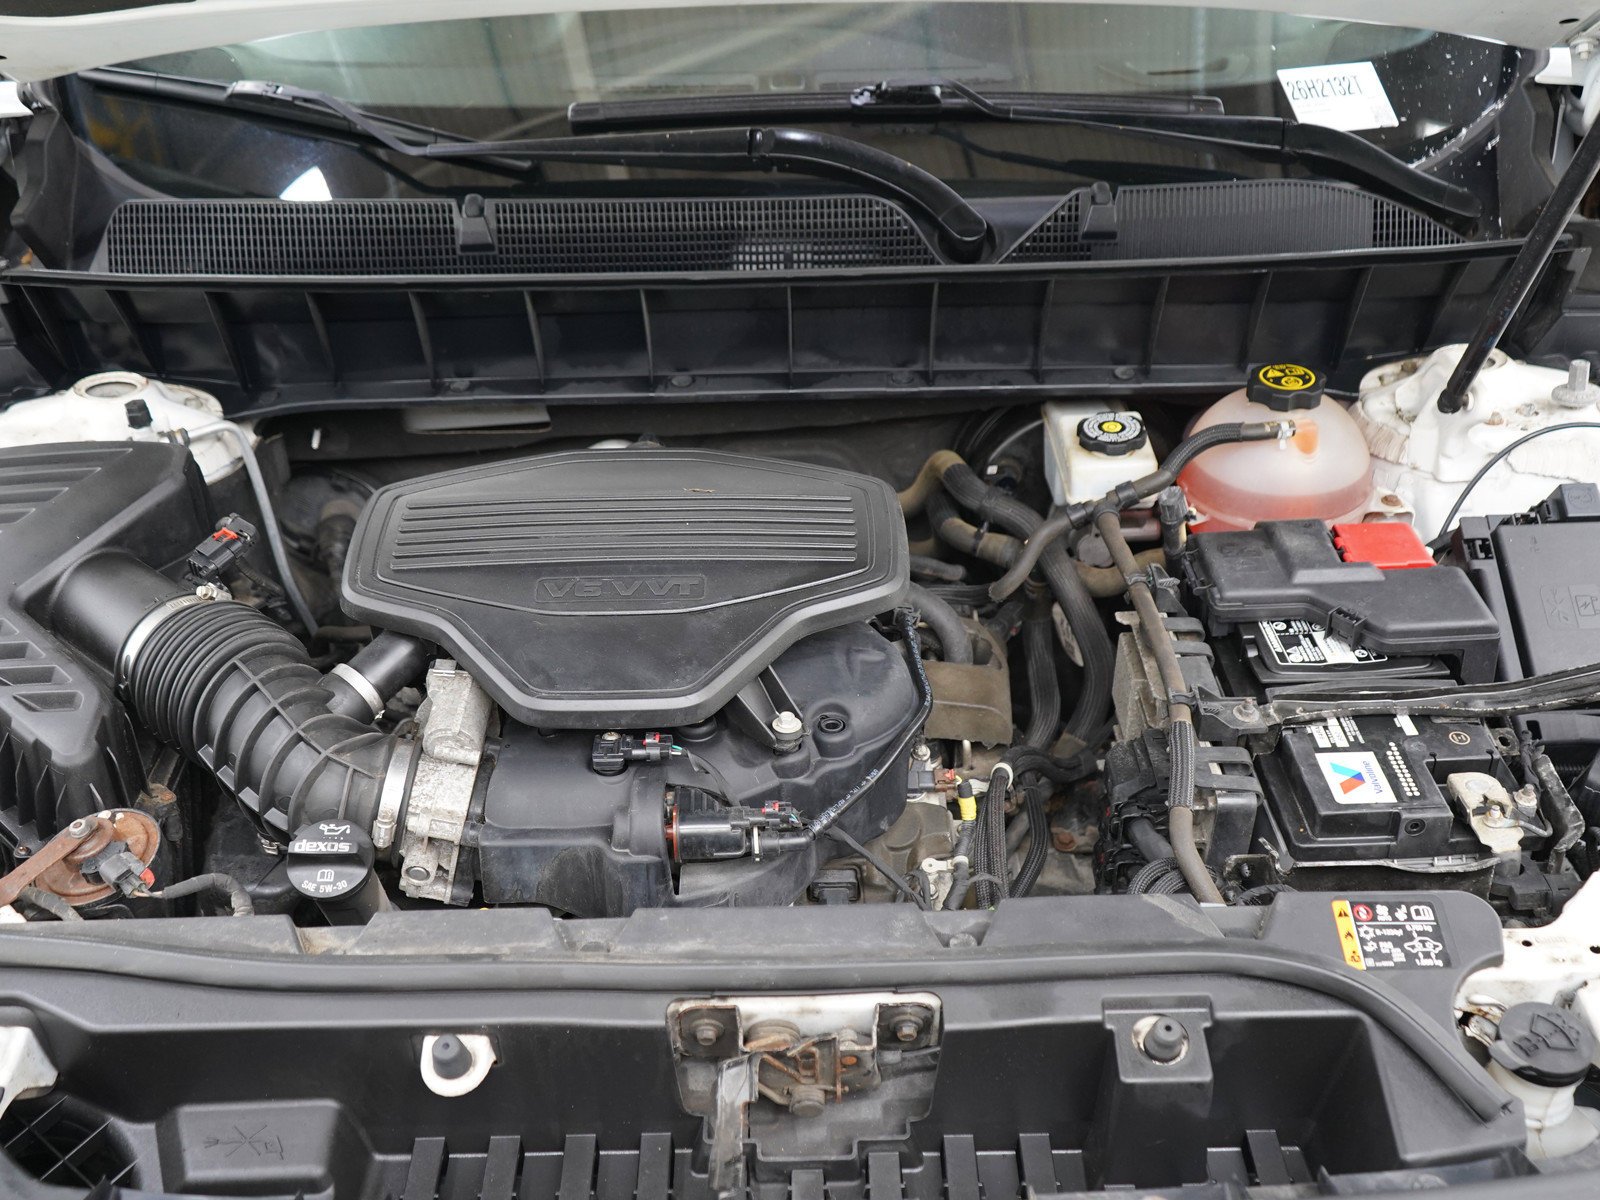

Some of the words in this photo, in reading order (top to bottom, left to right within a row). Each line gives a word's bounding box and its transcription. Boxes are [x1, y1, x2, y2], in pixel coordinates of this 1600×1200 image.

[1286, 74, 1363, 101] 26H2132T
[543, 577, 602, 598] V6
[611, 576, 699, 596] VVT
[1363, 760, 1383, 794] Valvoline
[294, 839, 352, 852] dexos
[302, 880, 317, 892] SAE
[319, 880, 348, 893] 5W-30
